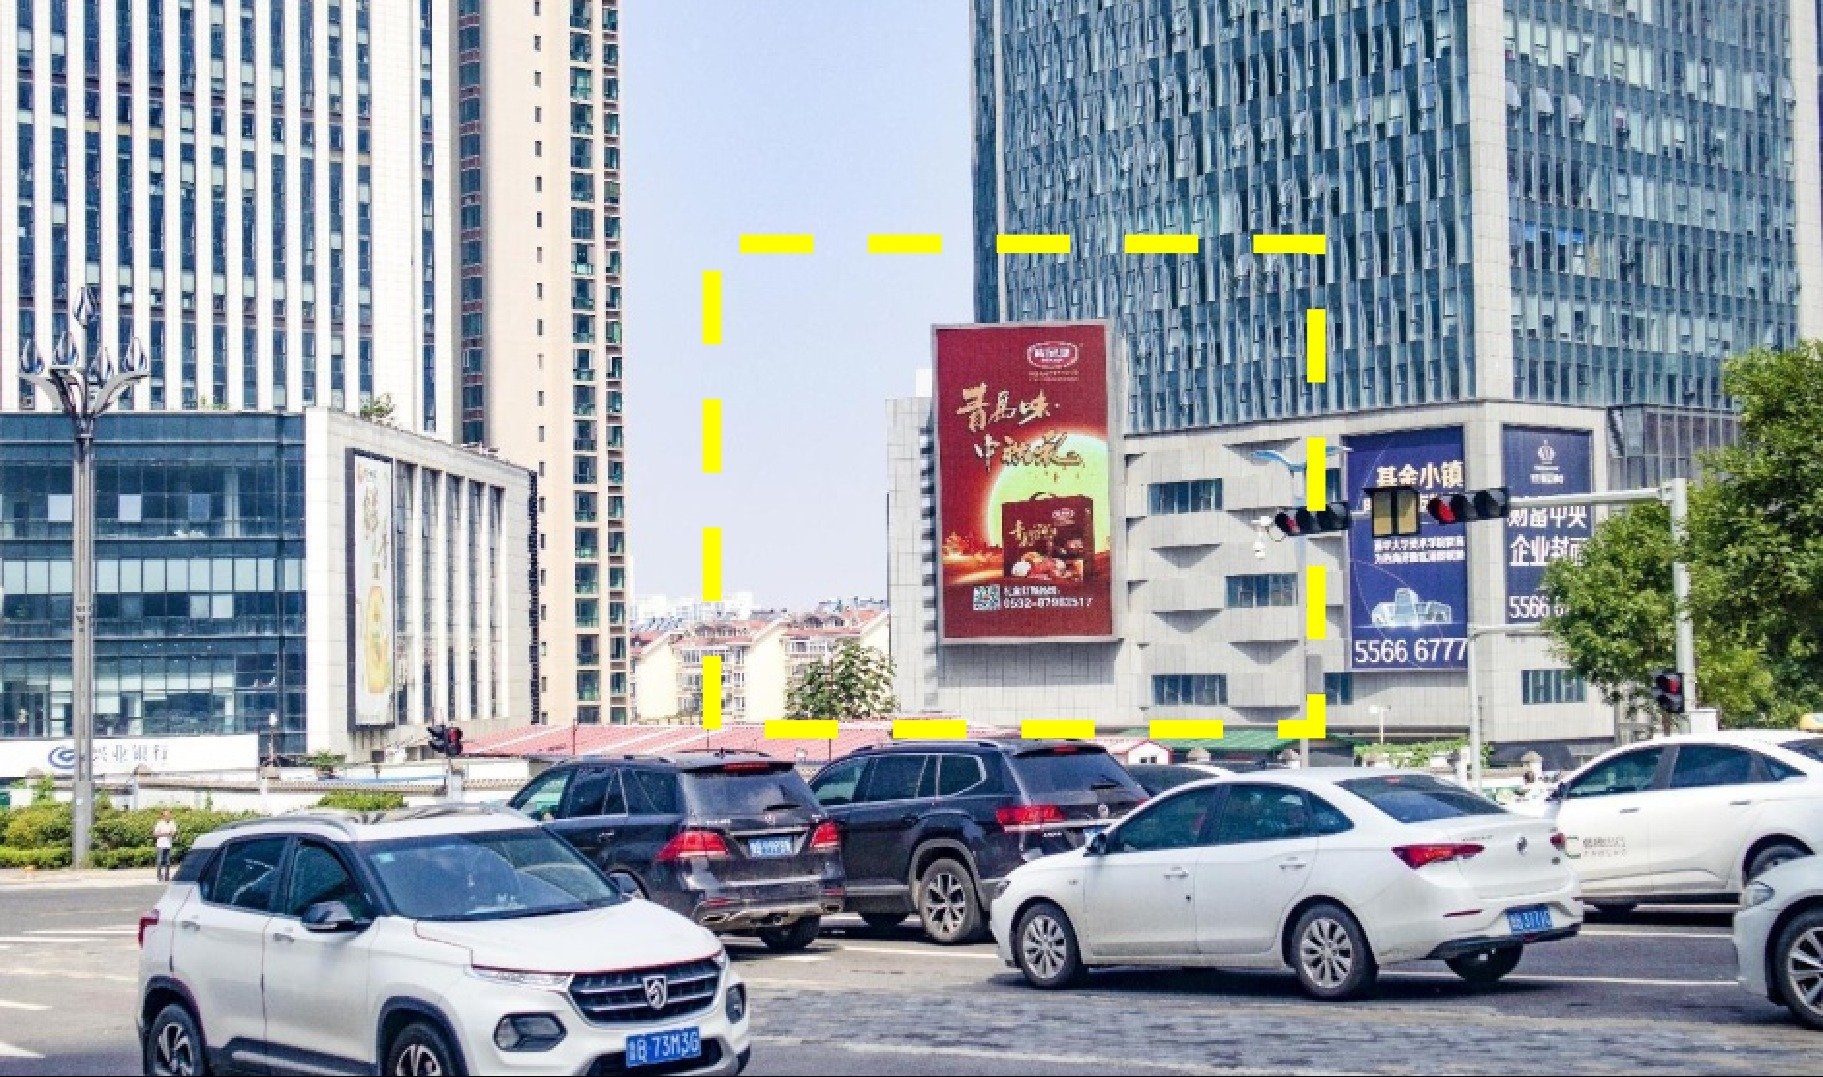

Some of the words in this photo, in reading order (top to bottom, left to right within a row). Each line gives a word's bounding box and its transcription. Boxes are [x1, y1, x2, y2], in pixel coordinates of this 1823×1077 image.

[1376, 460, 1464, 489] 基金小镇
[1508, 595, 1550, 618] 5566
[1355, 638, 1408, 663] 5566
[1414, 638, 1467, 662] 6777
